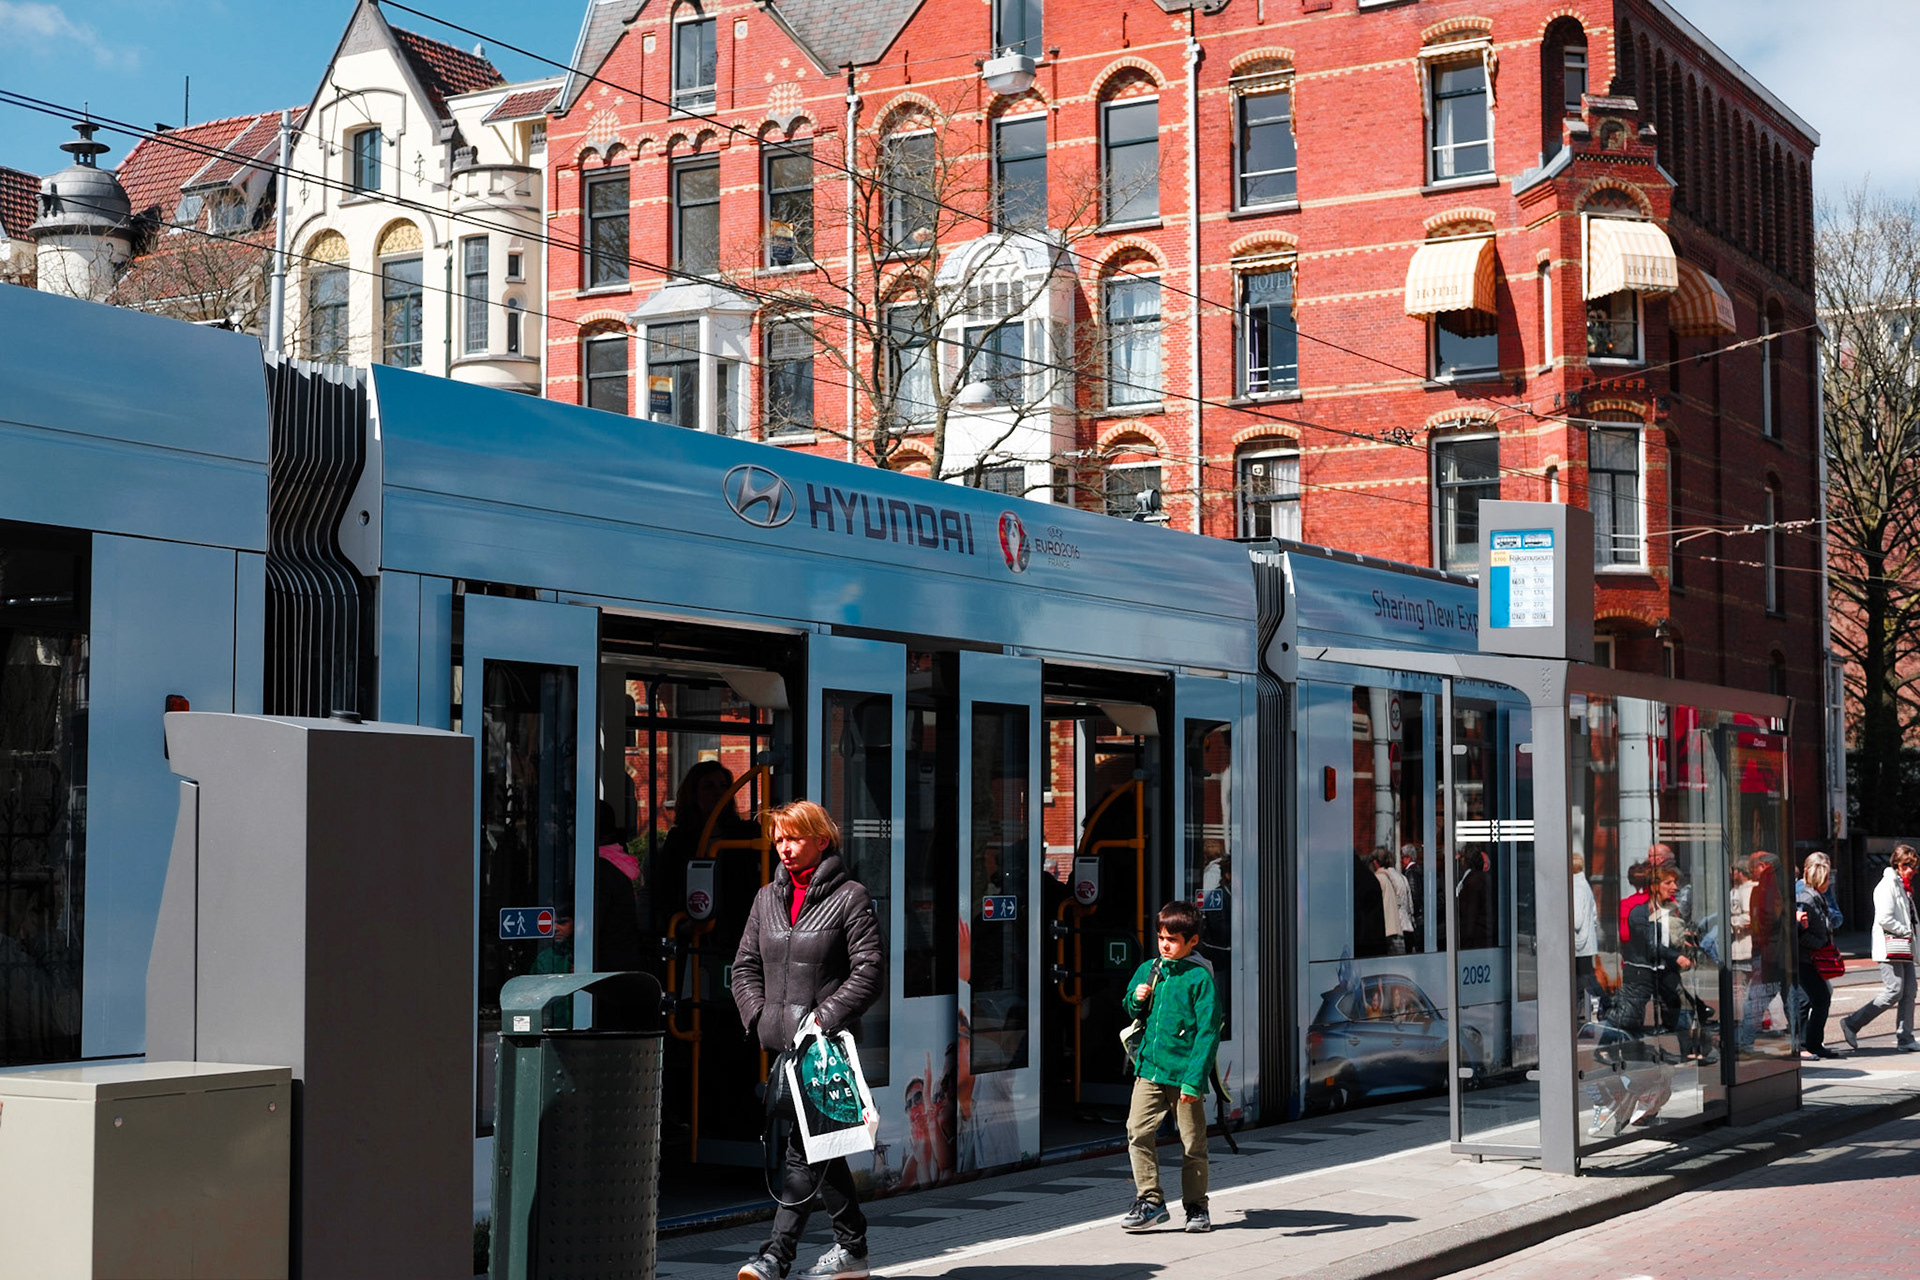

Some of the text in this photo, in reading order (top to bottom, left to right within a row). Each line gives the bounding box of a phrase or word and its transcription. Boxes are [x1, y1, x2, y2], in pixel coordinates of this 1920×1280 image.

[1248, 270, 1293, 291] HOTEL
[1627, 264, 1674, 279] HOTEL
[1416, 285, 1464, 299] HOTEL
[806, 482, 975, 556] HYUNDAI
[1034, 537, 1081, 560] EURO2016
[1509, 554, 1553, 563] Rijksmuseum
[1048, 557, 1071, 570] FRANCE
[1371, 589, 1425, 631] Sharing
[1426, 598, 1455, 629] New
[1462, 963, 1491, 986] 2092
